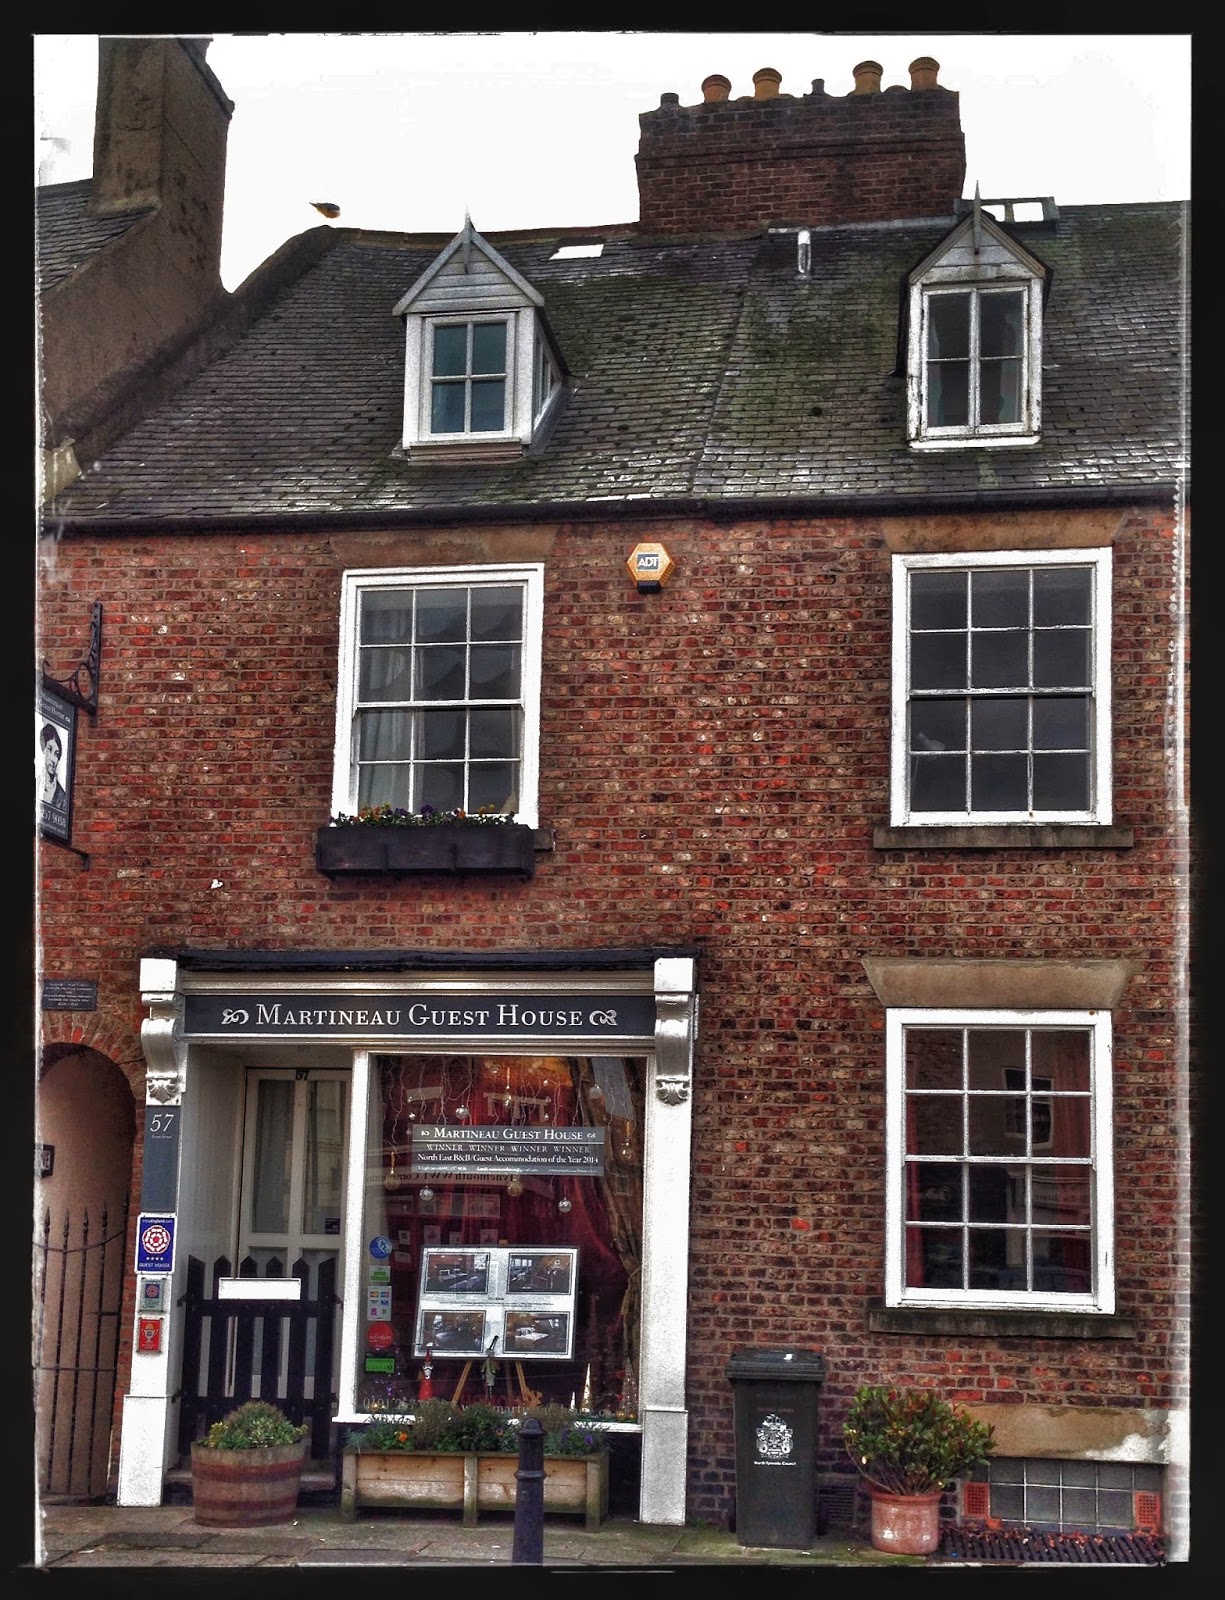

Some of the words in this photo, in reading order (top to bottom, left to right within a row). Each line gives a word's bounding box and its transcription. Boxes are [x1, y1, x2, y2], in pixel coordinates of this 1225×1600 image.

[637, 556, 660, 567] ADT
[255, 1002, 402, 1027] MARTINEAU
[408, 1003, 490, 1027] GUEST
[496, 1003, 584, 1027] HOUSE
[295, 1068, 310, 1081] 57
[149, 1112, 175, 1133] 57
[433, 1126, 500, 1140] MARTINEAU
[502, 1127, 541, 1141] GUEST
[543, 1128, 584, 1141] HOUSE
[426, 1143, 464, 1152] WINNER
[468, 1144, 506, 1152] WINNER
[510, 1145, 548, 1153] WINNER
[553, 1145, 591, 1153] WINNER
[417, 1153, 438, 1162] North
[438, 1153, 453, 1162] East
[494, 1154, 548, 1163] Accommodation
[547, 1154, 556, 1163] of
[556, 1154, 567, 1163] the
[567, 1155, 582, 1163] Year
[582, 1155, 599, 1164] 2014
